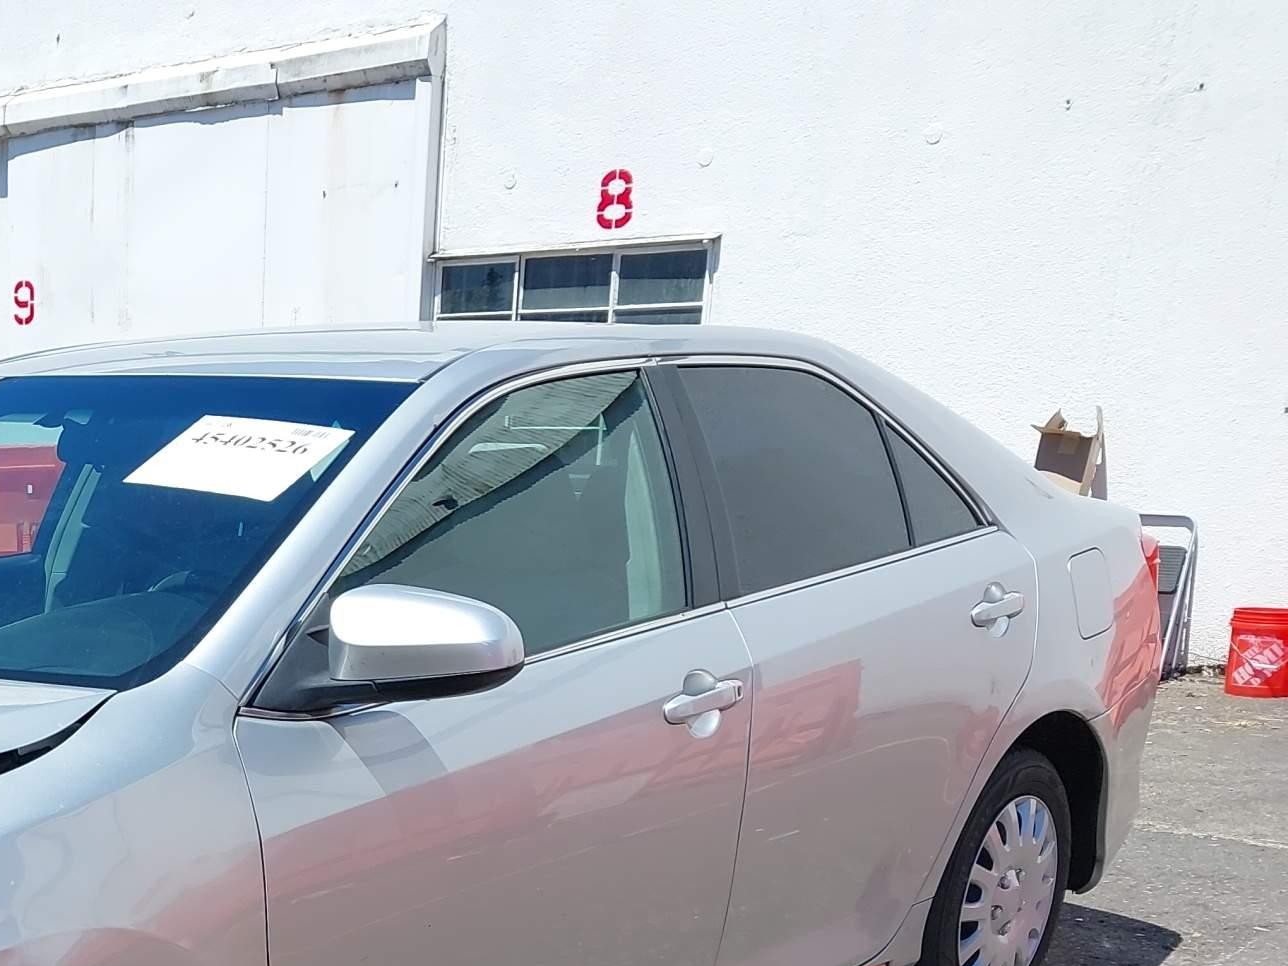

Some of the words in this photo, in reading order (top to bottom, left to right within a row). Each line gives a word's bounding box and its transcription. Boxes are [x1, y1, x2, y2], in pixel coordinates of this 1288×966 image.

[596, 169, 633, 229] 8
[13, 281, 34, 325] 9
[191, 432, 311, 454] 45402526
